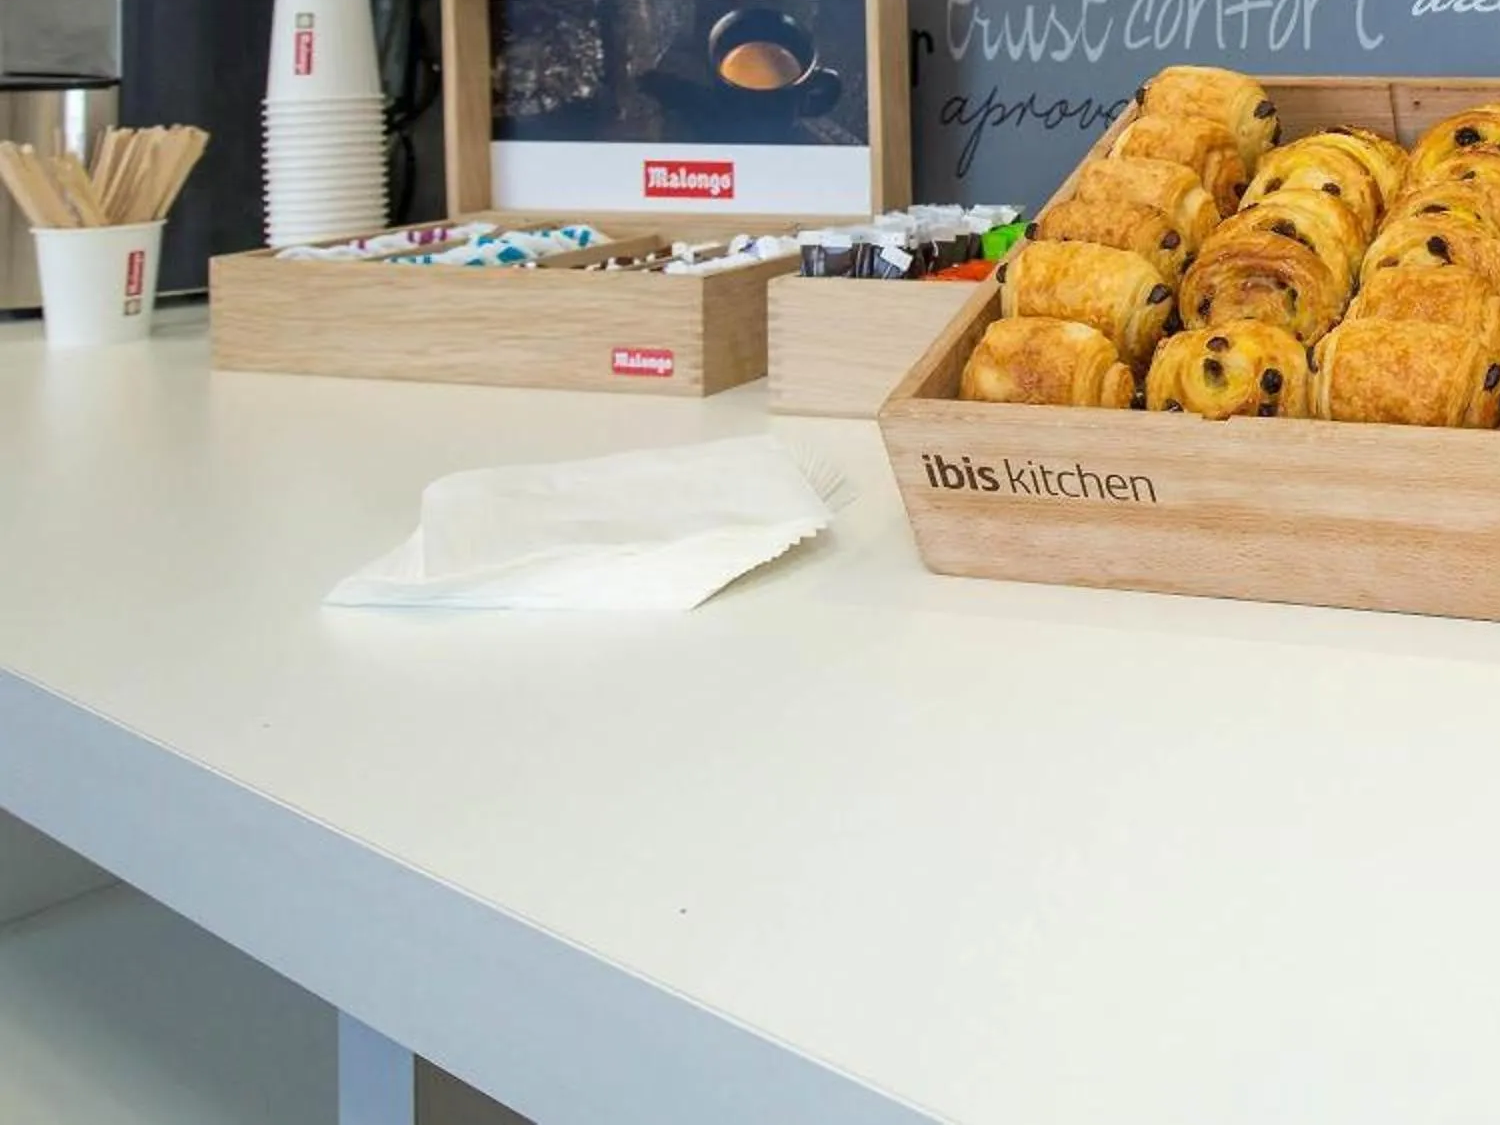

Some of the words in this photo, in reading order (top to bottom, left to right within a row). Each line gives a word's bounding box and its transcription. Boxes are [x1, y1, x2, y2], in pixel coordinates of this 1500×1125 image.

[646, 165, 732, 196] Malongo
[922, 454, 1000, 493] ibis
[1003, 458, 1158, 503] kitchen
